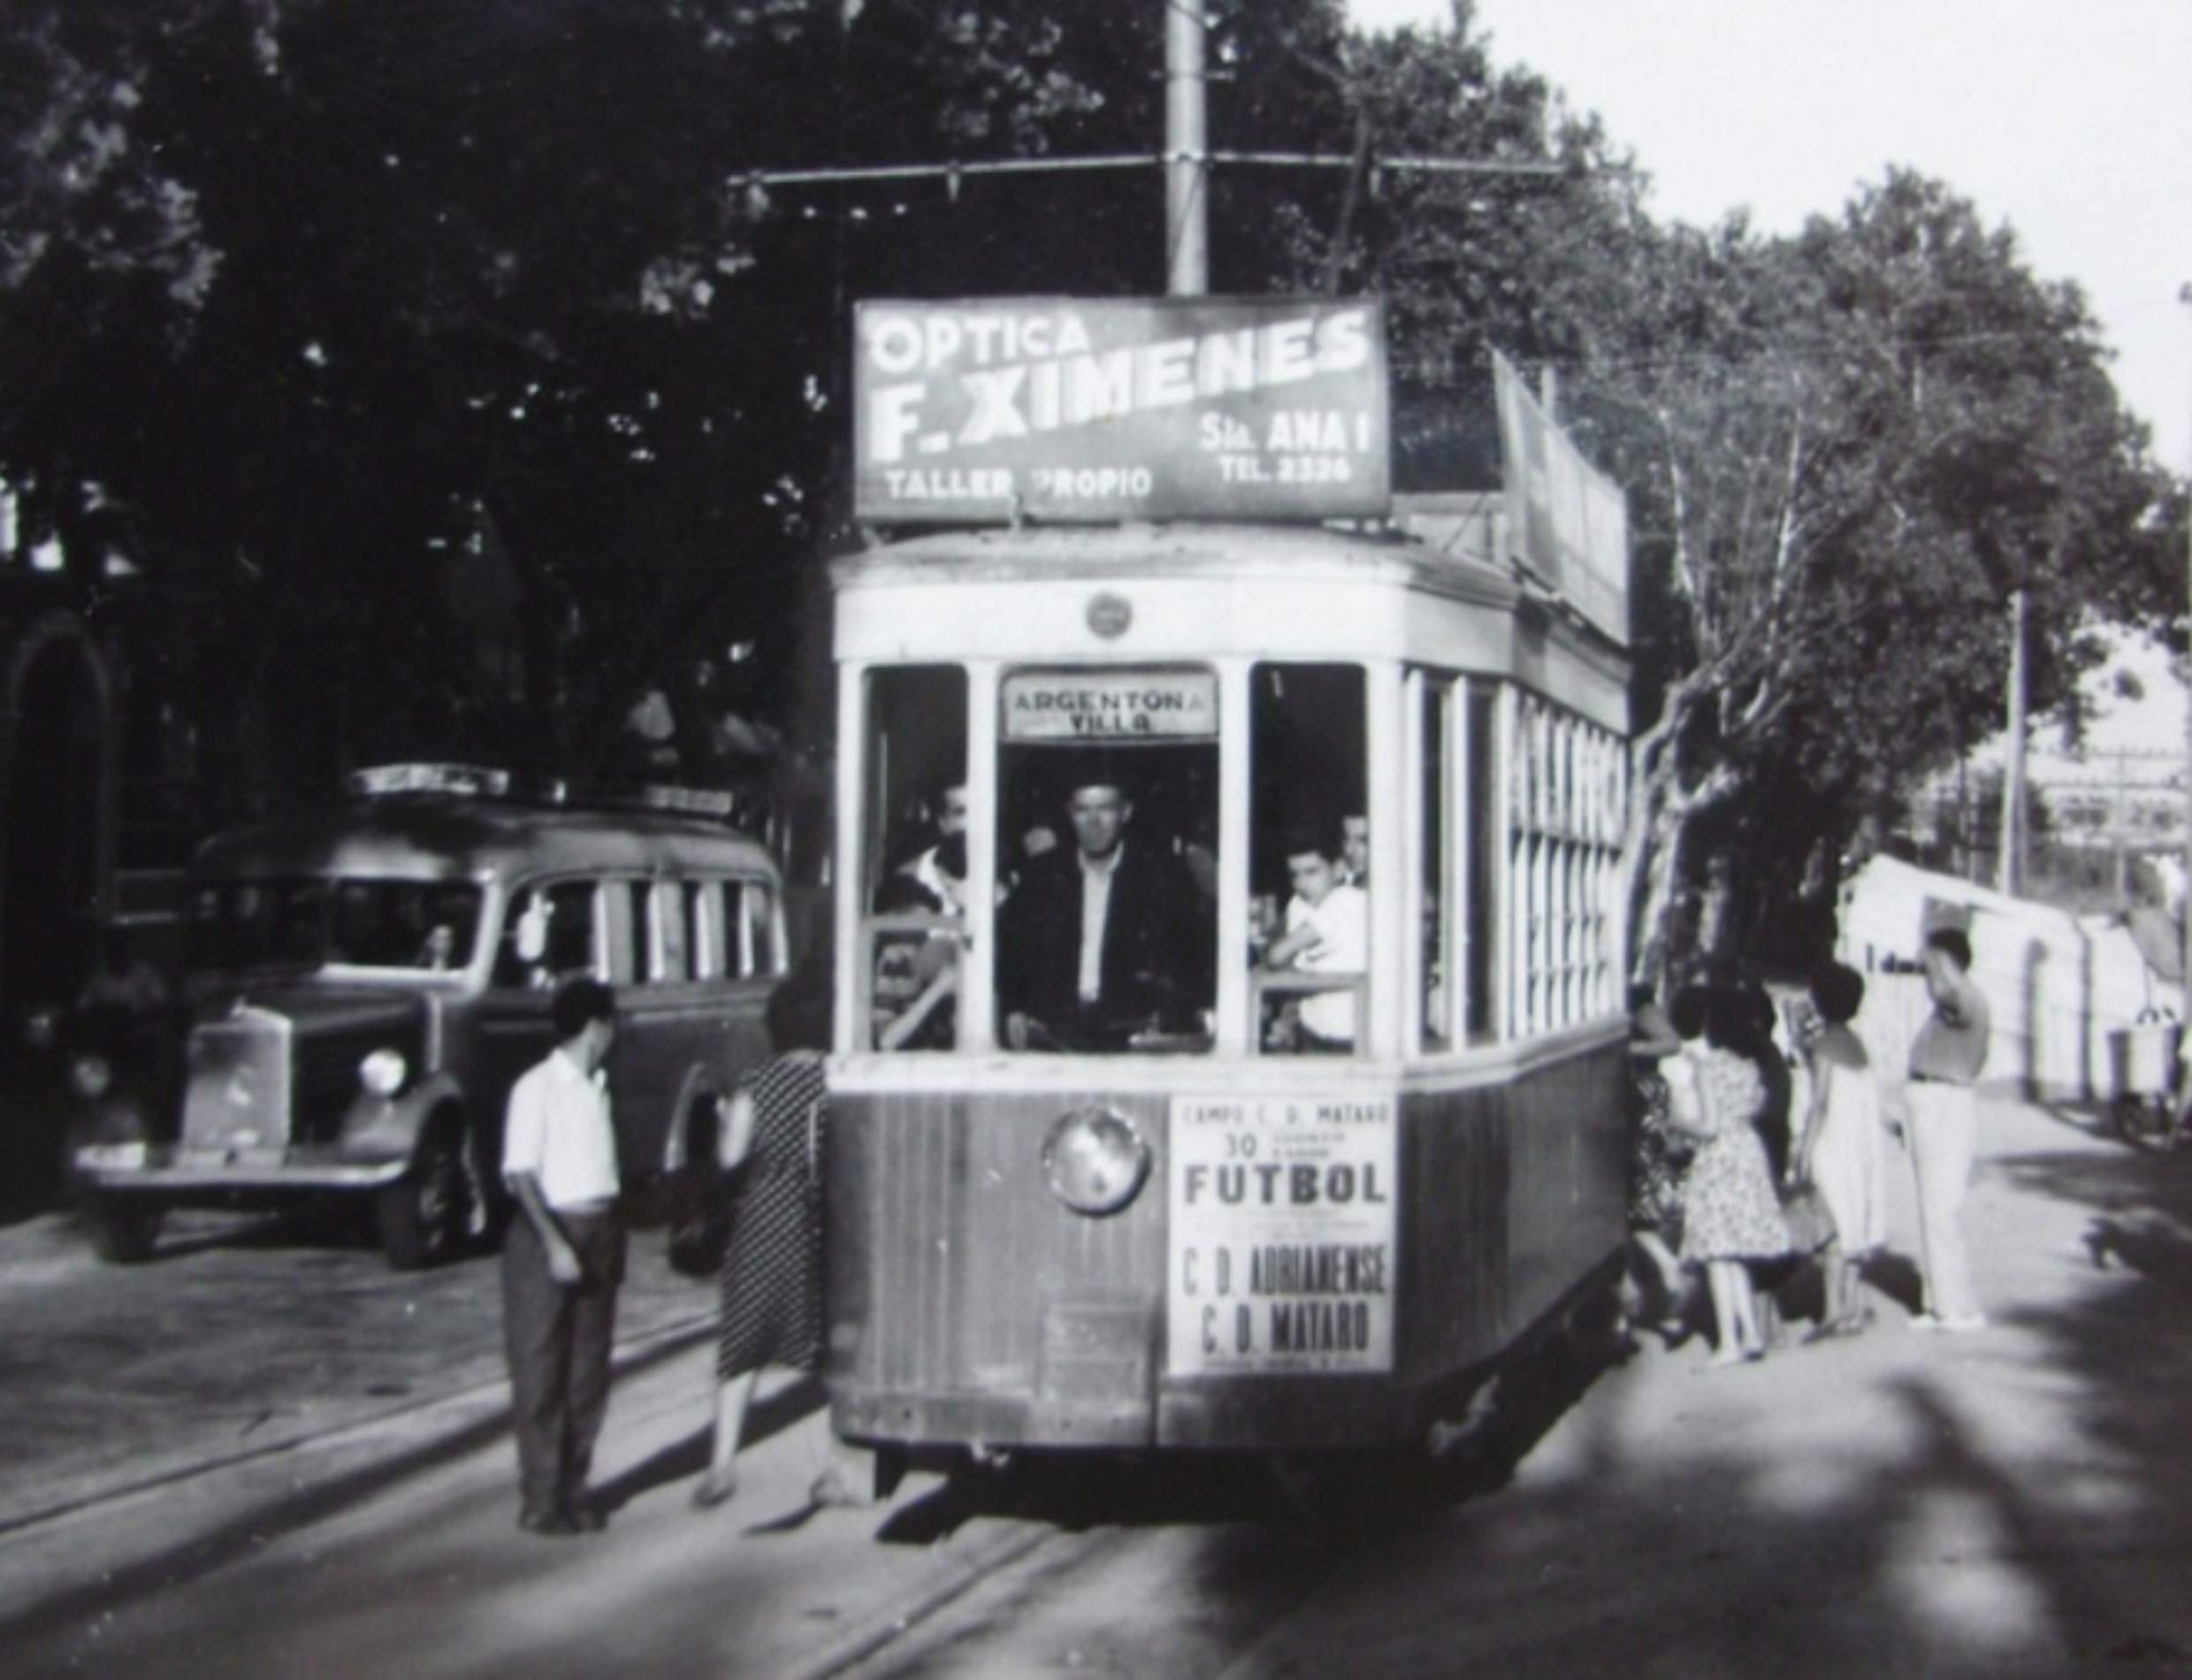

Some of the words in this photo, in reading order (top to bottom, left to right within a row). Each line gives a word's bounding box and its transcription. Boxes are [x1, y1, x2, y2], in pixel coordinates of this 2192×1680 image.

[871, 313, 1090, 372] OPTICA
[957, 309, 1369, 446] XIMENES
[1266, 410, 1348, 452] ANA
[885, 467, 1014, 499] TALLER
[1031, 467, 1153, 498] PROPIO
[1016, 690, 1203, 710] ARGENTONA
[1185, 1163, 1386, 1205] FUTBOL
